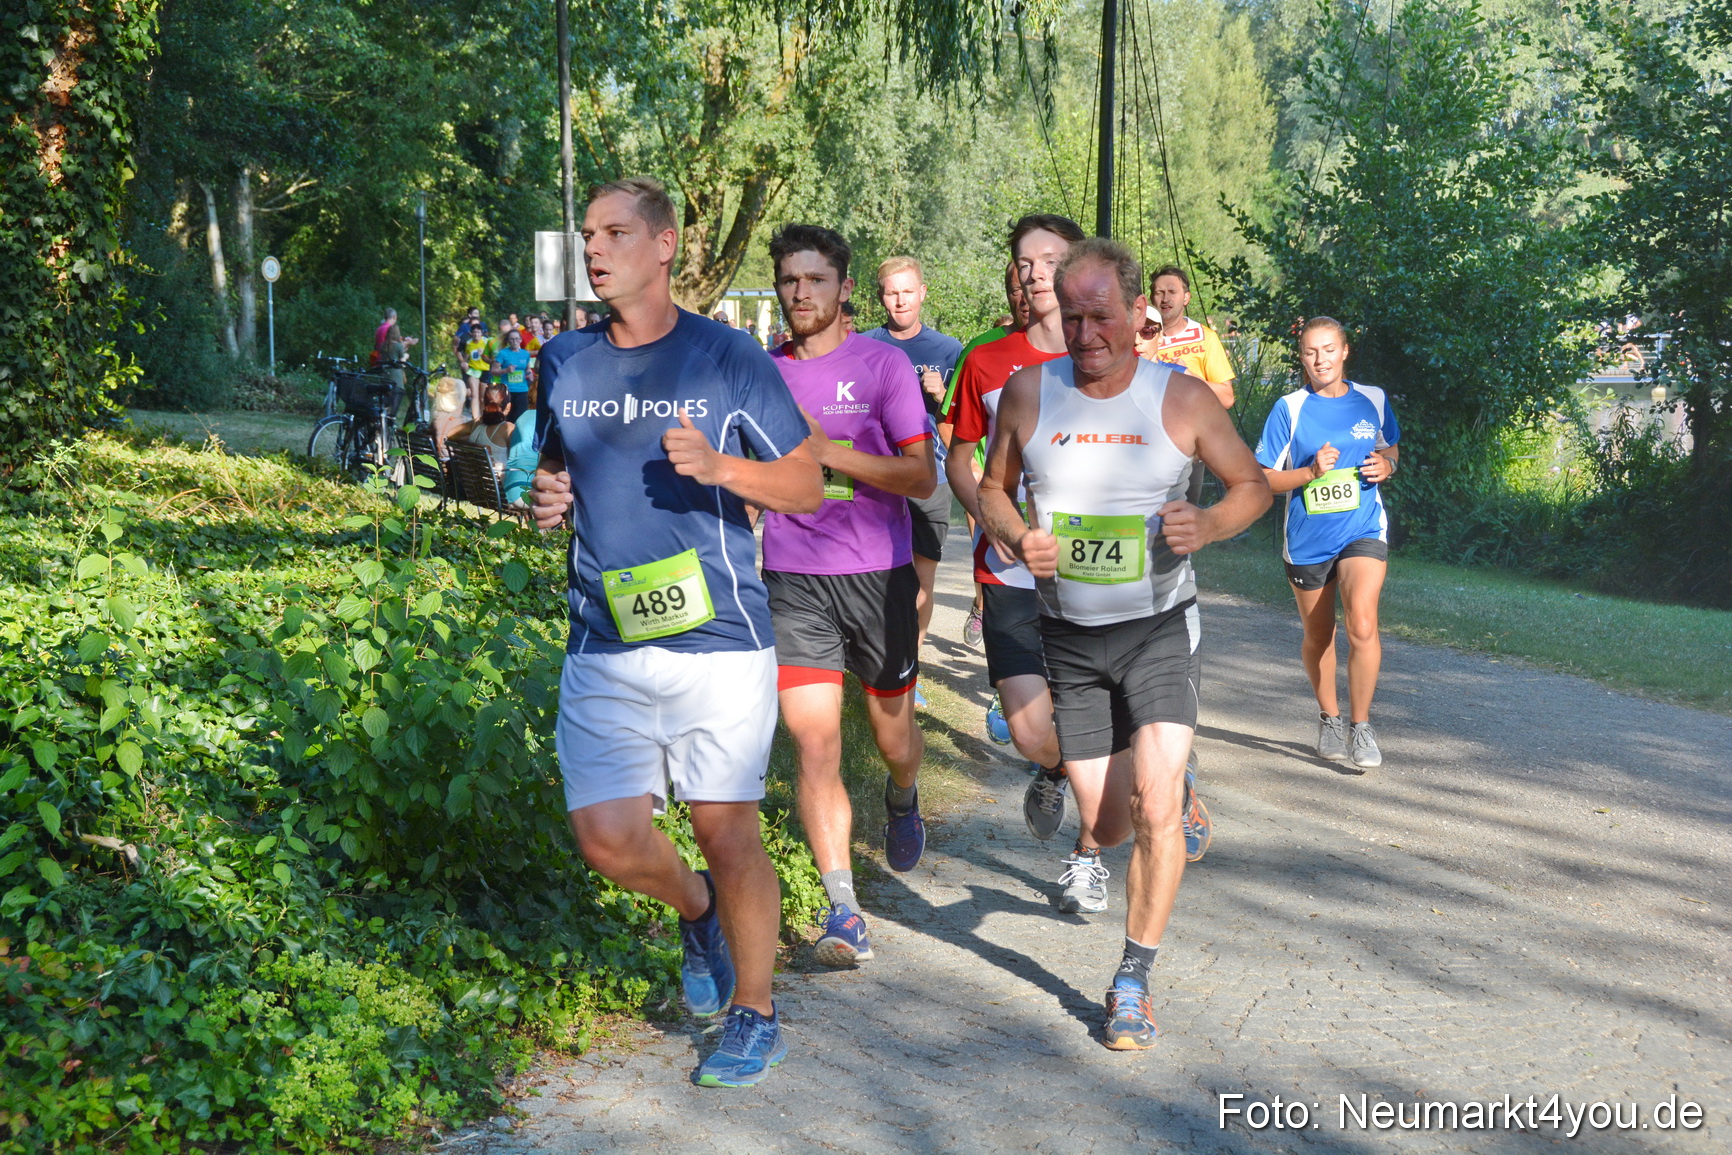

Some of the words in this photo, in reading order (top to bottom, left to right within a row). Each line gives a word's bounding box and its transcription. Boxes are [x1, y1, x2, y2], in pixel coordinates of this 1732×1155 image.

[1173, 345, 1206, 358] BÖGL
[836, 381, 856, 402] K
[562, 399, 619, 418] EURO
[641, 398, 708, 418] POLES
[822, 403, 870, 411] KÜFNER
[1076, 433, 1149, 446] KLEBL
[1310, 483, 1352, 502] 1968
[1071, 538, 1123, 564] 874
[1069, 562, 1099, 571] Blomeier
[632, 585, 686, 618] 489
[640, 617, 660, 627] Wirth
[661, 611, 689, 622] Markus
